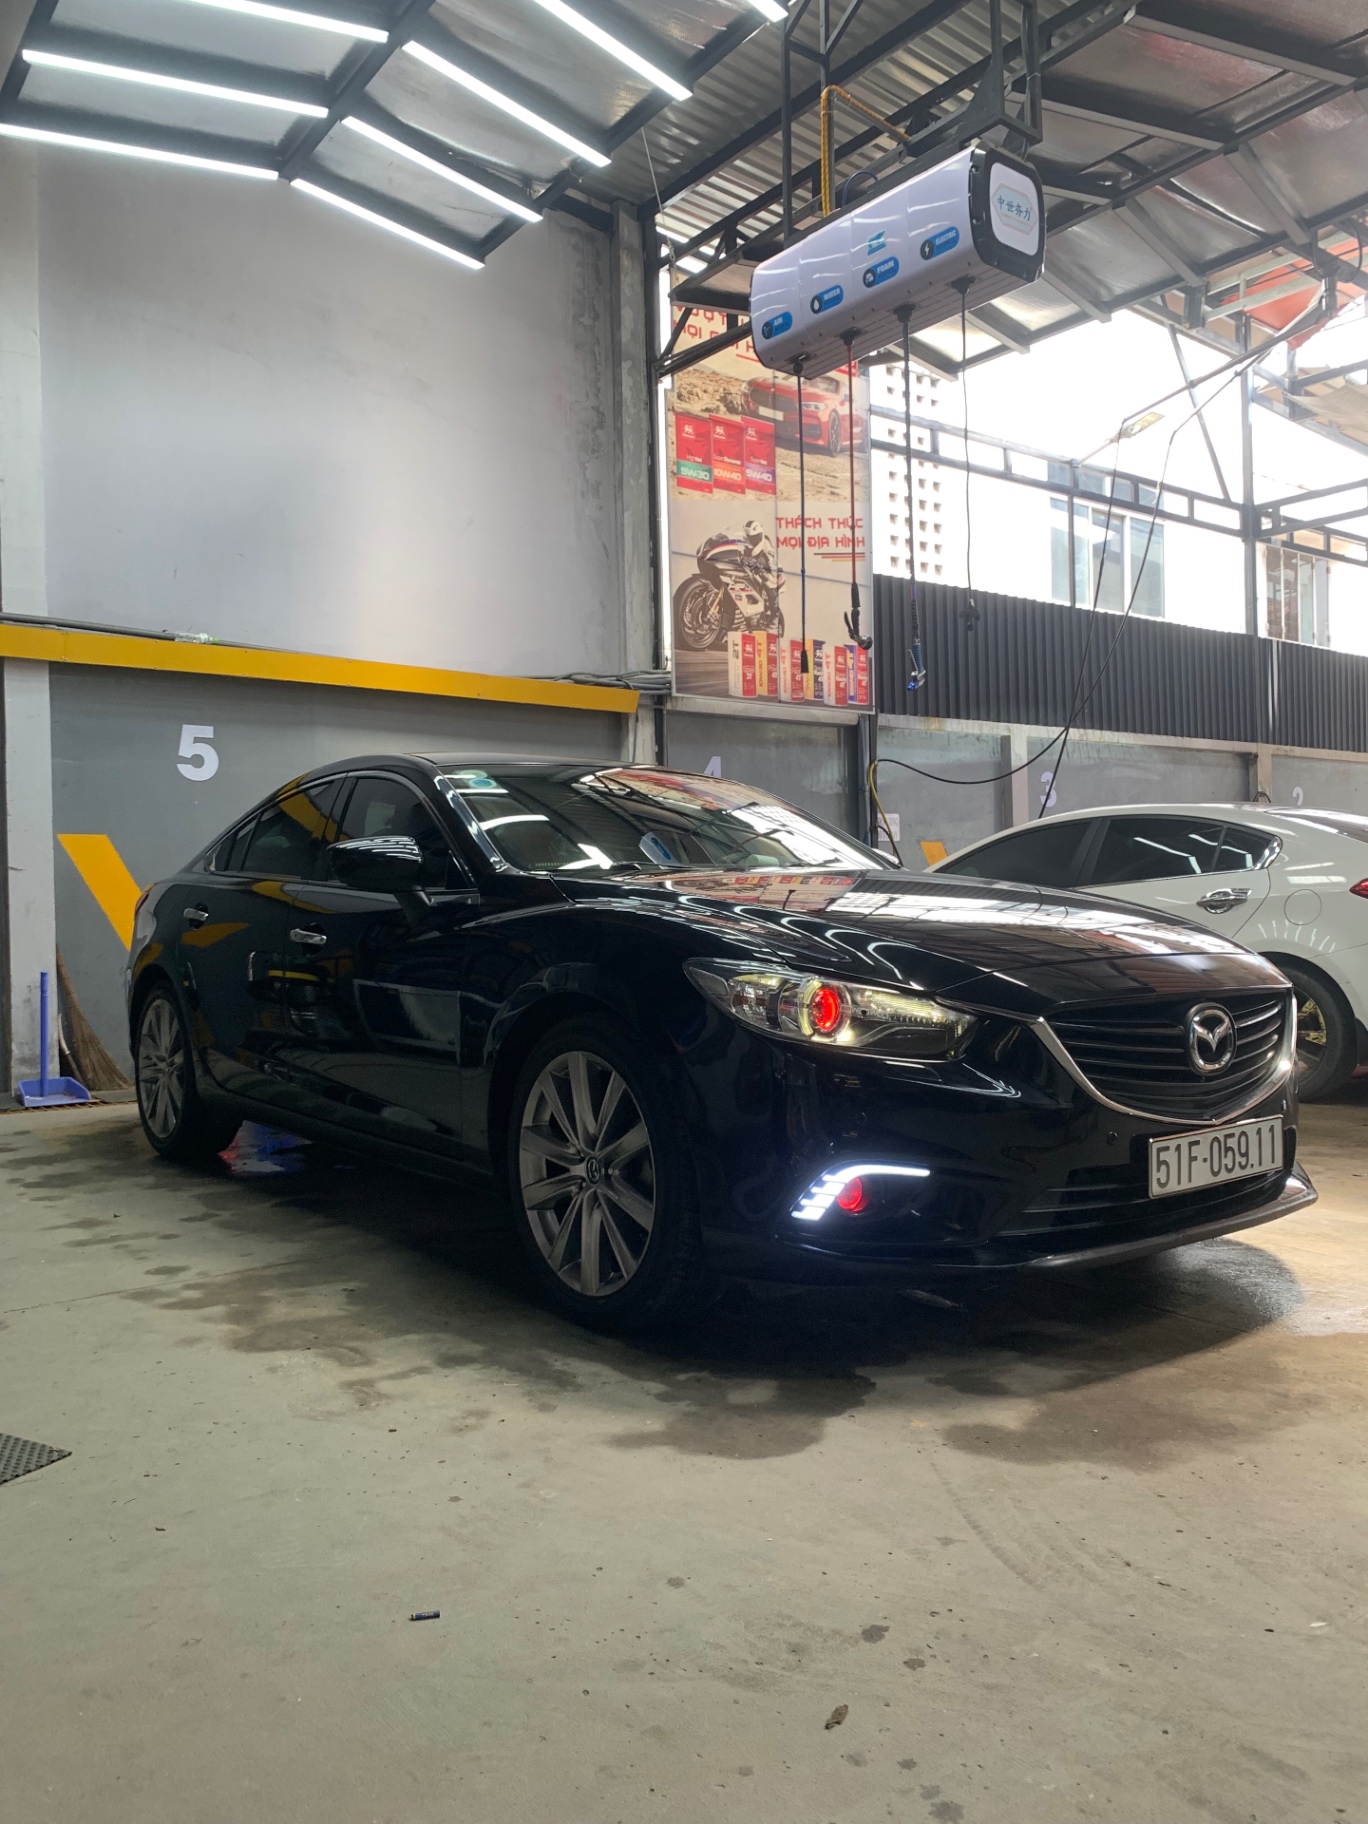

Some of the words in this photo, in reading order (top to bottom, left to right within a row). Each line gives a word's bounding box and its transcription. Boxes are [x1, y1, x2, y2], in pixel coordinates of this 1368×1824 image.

[935, 229, 957, 246] ELECTRIC
[877, 260, 895, 274] FOAM
[823, 287, 841, 301] WATER
[773, 316, 783, 326] AIR
[775, 514, 822, 530] THÁCH
[776, 536, 803, 550] MỌI
[807, 535, 830, 550] ĐỊA
[835, 533, 866, 549] HÌNH
[177, 724, 219, 782] 5
[1040, 771, 1057, 808] 3
[1156, 1124, 1276, 1189] 51F-059.11
